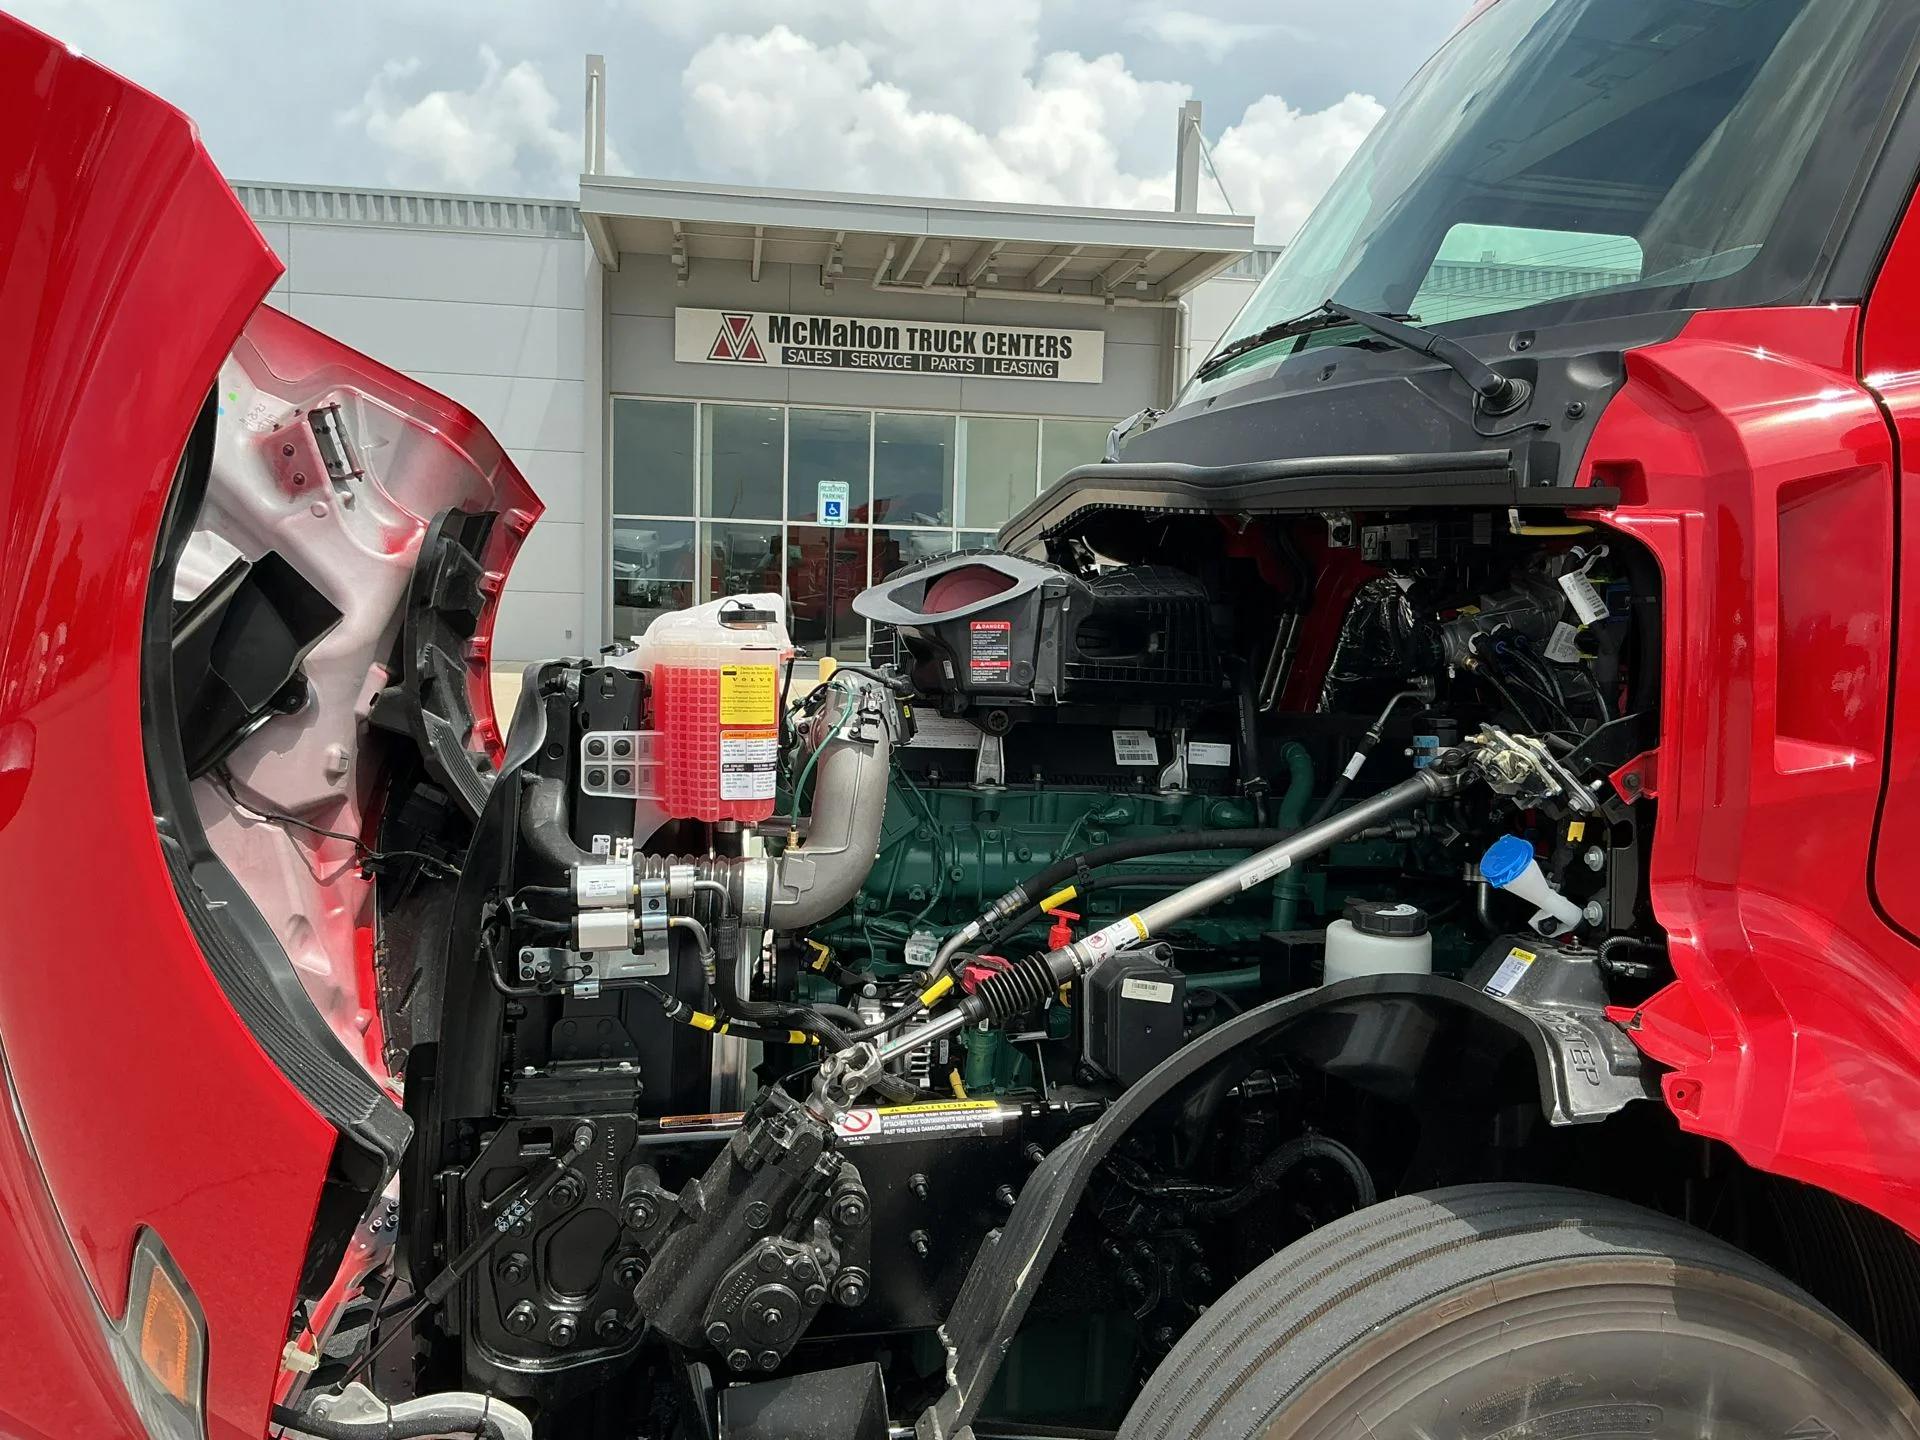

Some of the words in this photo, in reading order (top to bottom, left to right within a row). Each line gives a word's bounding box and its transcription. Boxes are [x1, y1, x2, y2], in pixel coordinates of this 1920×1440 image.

[768, 315, 900, 350] McMahon
[906, 327, 977, 354] TRUCK
[981, 331, 1073, 360] CENTERS
[787, 349, 833, 365] SALES
[850, 352, 912, 369] SERVICE
[930, 357, 975, 372] PARTS
[993, 360, 1053, 376] LEASING
[821, 485, 847, 493] RESERVED
[1555, 1024, 1600, 1087] STEP
[920, 1124, 946, 1132] DAMAGING
